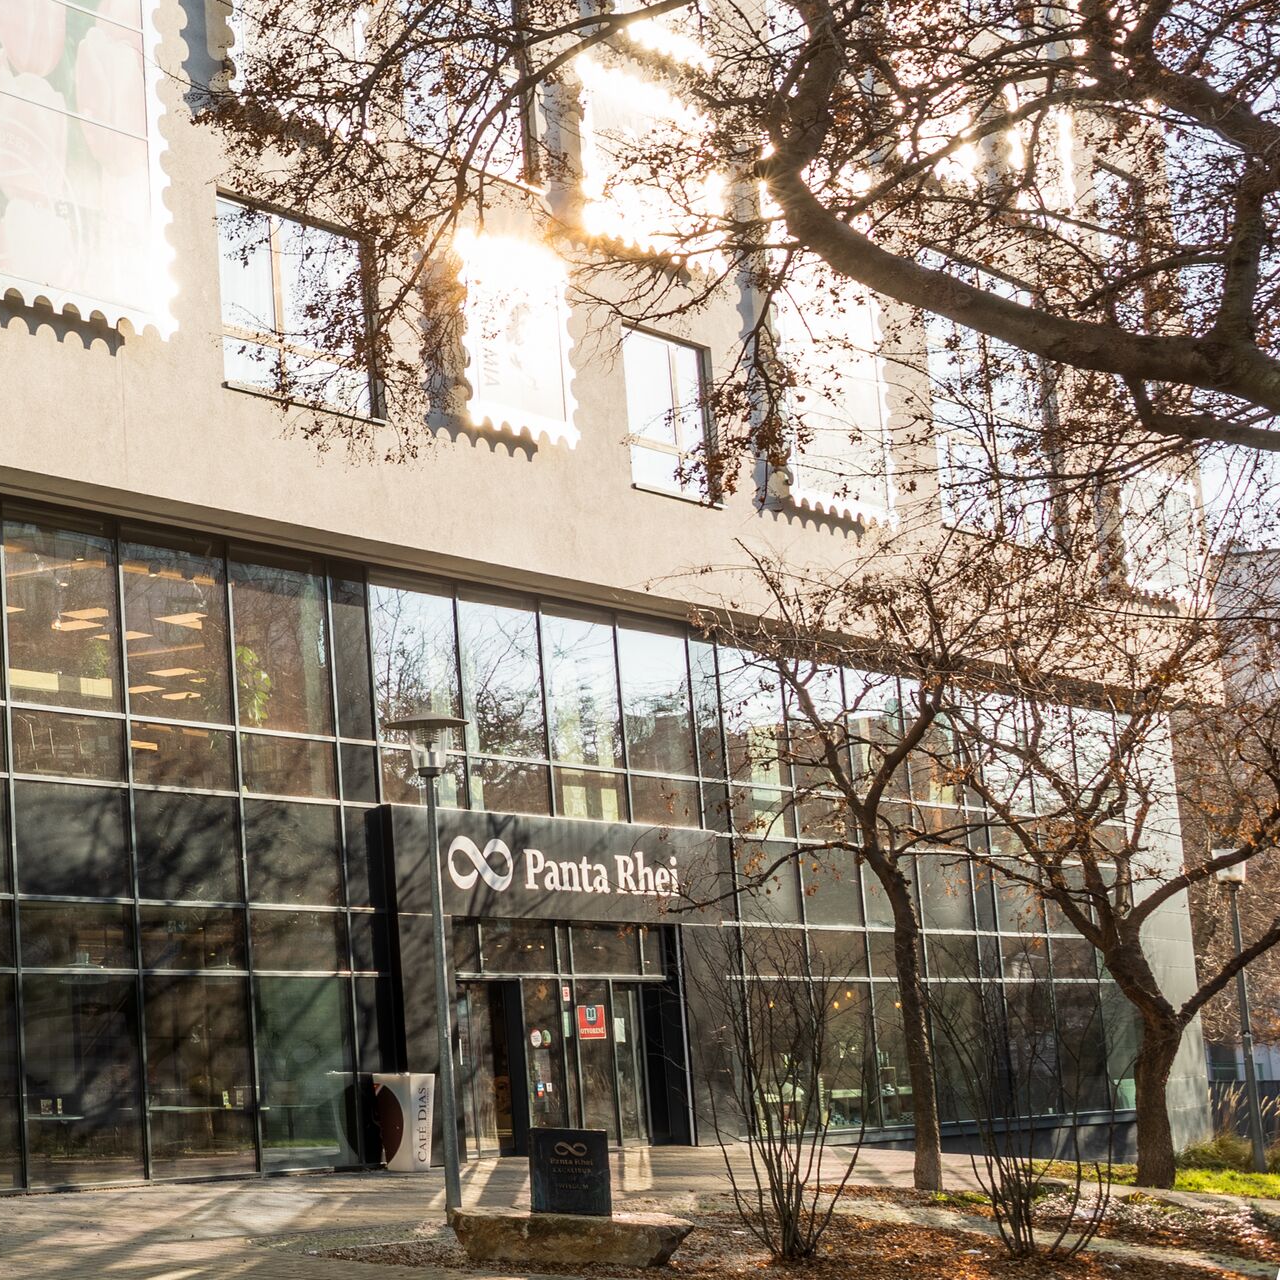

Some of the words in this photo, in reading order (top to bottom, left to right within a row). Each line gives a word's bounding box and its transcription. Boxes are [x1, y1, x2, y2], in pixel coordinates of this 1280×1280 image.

[523, 848, 612, 894] Panta
[613, 850, 681, 897] Rhei
[417, 1087, 427, 1121] DIAS
[416, 1126, 427, 1162] CAFÉ
